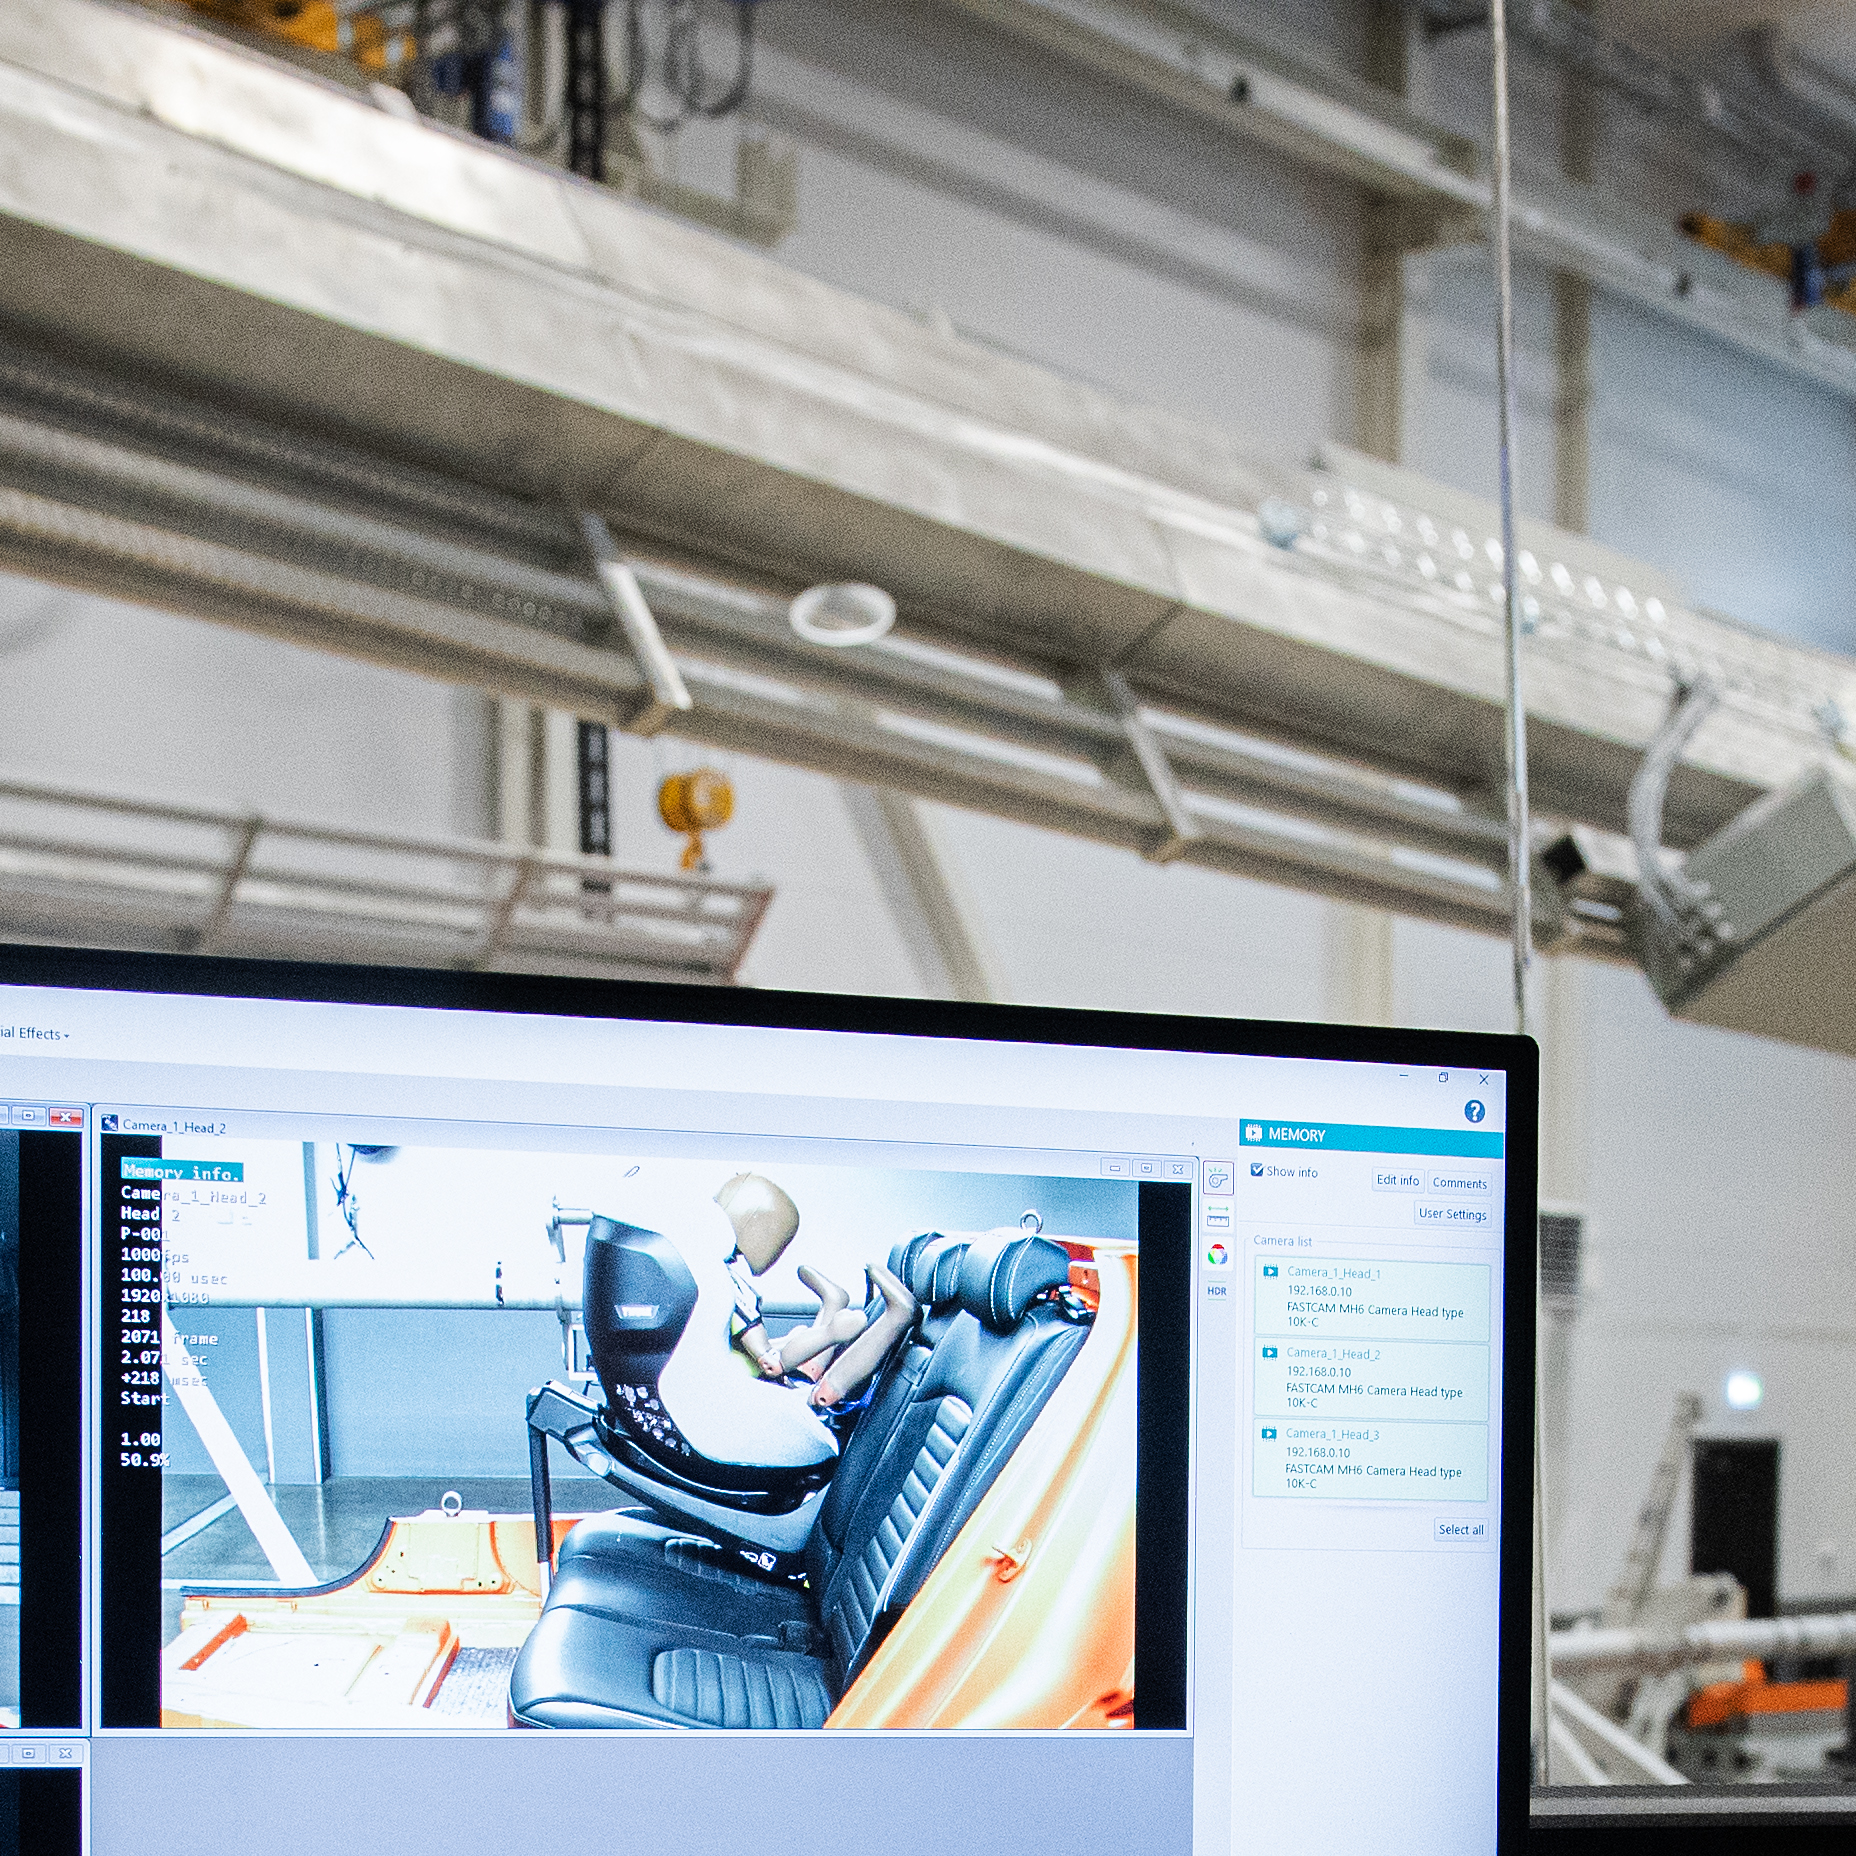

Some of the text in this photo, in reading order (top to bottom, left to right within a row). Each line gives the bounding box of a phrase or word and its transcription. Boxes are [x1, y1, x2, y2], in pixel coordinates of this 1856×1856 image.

[19, 1027, 60, 1041] Effects
[123, 1119, 226, 1136] Camera_1_Head_2
[1269, 1127, 1325, 1142] MEMORY
[123, 1164, 238, 1181] Memory info.
[1267, 1166, 1317, 1178] Show info
[1377, 1175, 1420, 1186] Edit info
[1433, 1177, 1487, 1190] Comments
[121, 1206, 159, 1221] Head
[1420, 1209, 1487, 1223] User Settings
[1254, 1235, 1312, 1247] Camera list
[1288, 1267, 1380, 1279] Camera_1_Head_1
[1207, 1287, 1226, 1296] HDR
[1288, 1286, 1352, 1297] 192.168.0.10
[121, 1309, 150, 1323] 218
[1287, 1302, 1464, 1320] FASTCAM MH6 Camera Head type
[121, 1330, 218, 1345] 2071 frame
[1287, 1348, 1380, 1360] Camera_1_Head_2
[1287, 1366, 1351, 1378] 192.168.0.10
[121, 1391, 170, 1405] Start
[121, 1433, 160, 1446] 1.00
[1286, 1428, 1380, 1442] Camera_1_Head_3
[1286, 1448, 1350, 1458] 192.168.0.10
[121, 1453, 170, 1467] 50.9%
[1286, 1464, 1462, 1480] FASTCAM MH6 Camera Head type
[1286, 1479, 1317, 1488] 10K-C
[1440, 1525, 1484, 1535] Select all
